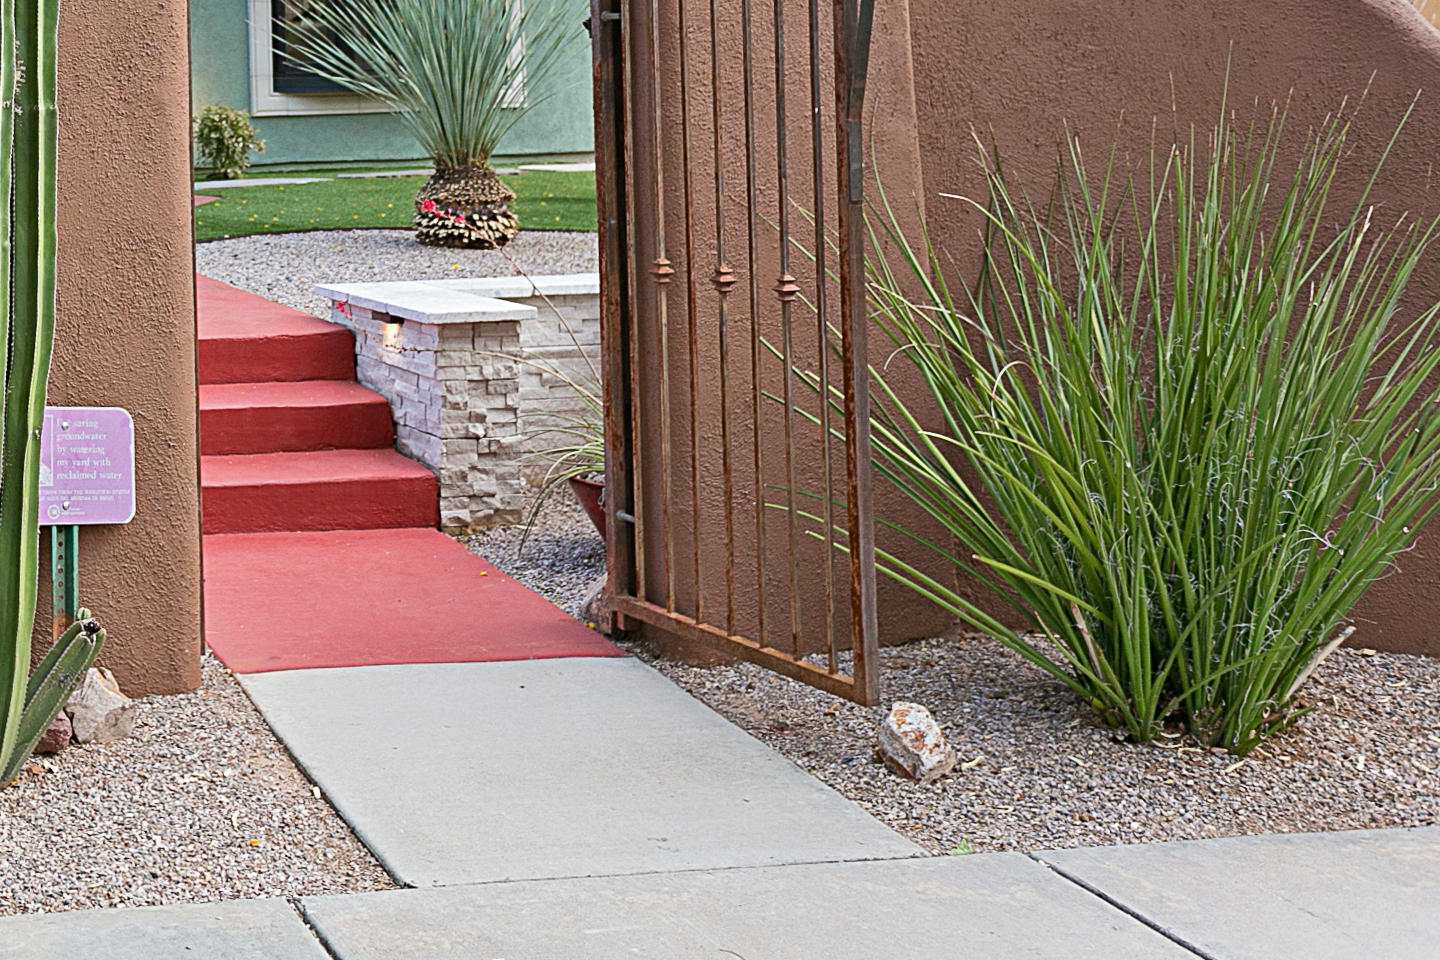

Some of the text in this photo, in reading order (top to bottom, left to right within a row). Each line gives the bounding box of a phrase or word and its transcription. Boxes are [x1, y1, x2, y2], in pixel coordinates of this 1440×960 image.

[56, 430, 107, 442] groundwater
[56, 444, 66, 455] by
[56, 456, 111, 469] my yard with
[56, 470, 97, 480] reclaimed
